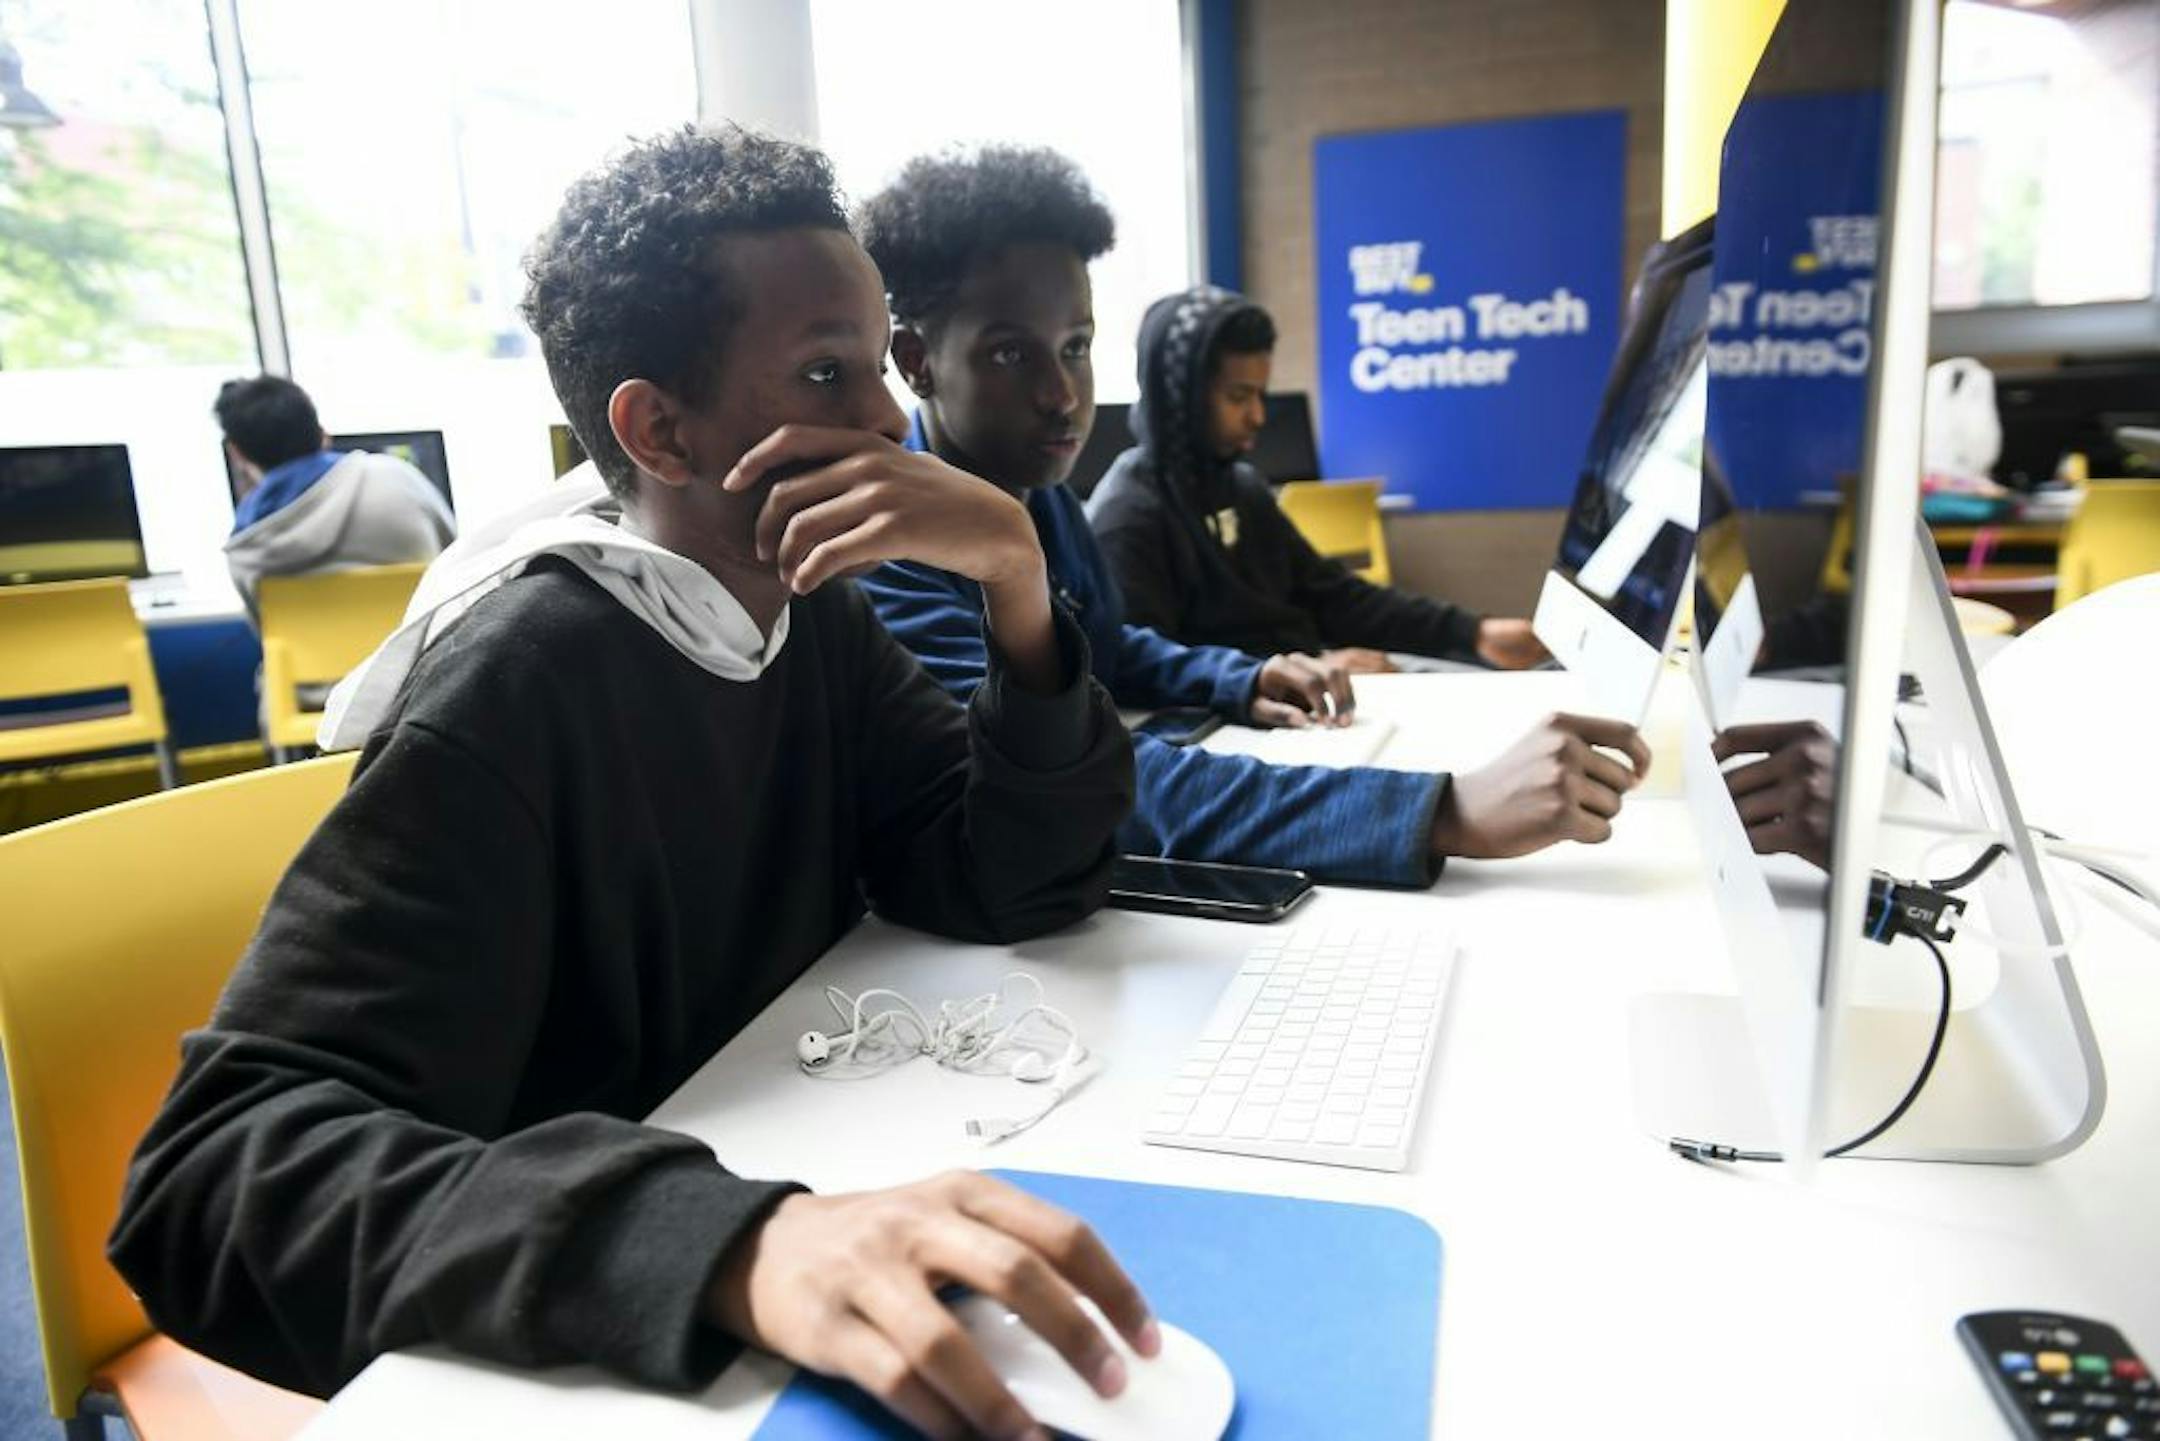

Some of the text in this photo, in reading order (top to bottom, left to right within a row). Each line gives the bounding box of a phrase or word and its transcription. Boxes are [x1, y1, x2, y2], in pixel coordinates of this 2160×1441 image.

[1349, 288, 1588, 347] Teen Tech
[1350, 346, 1517, 392] Center
